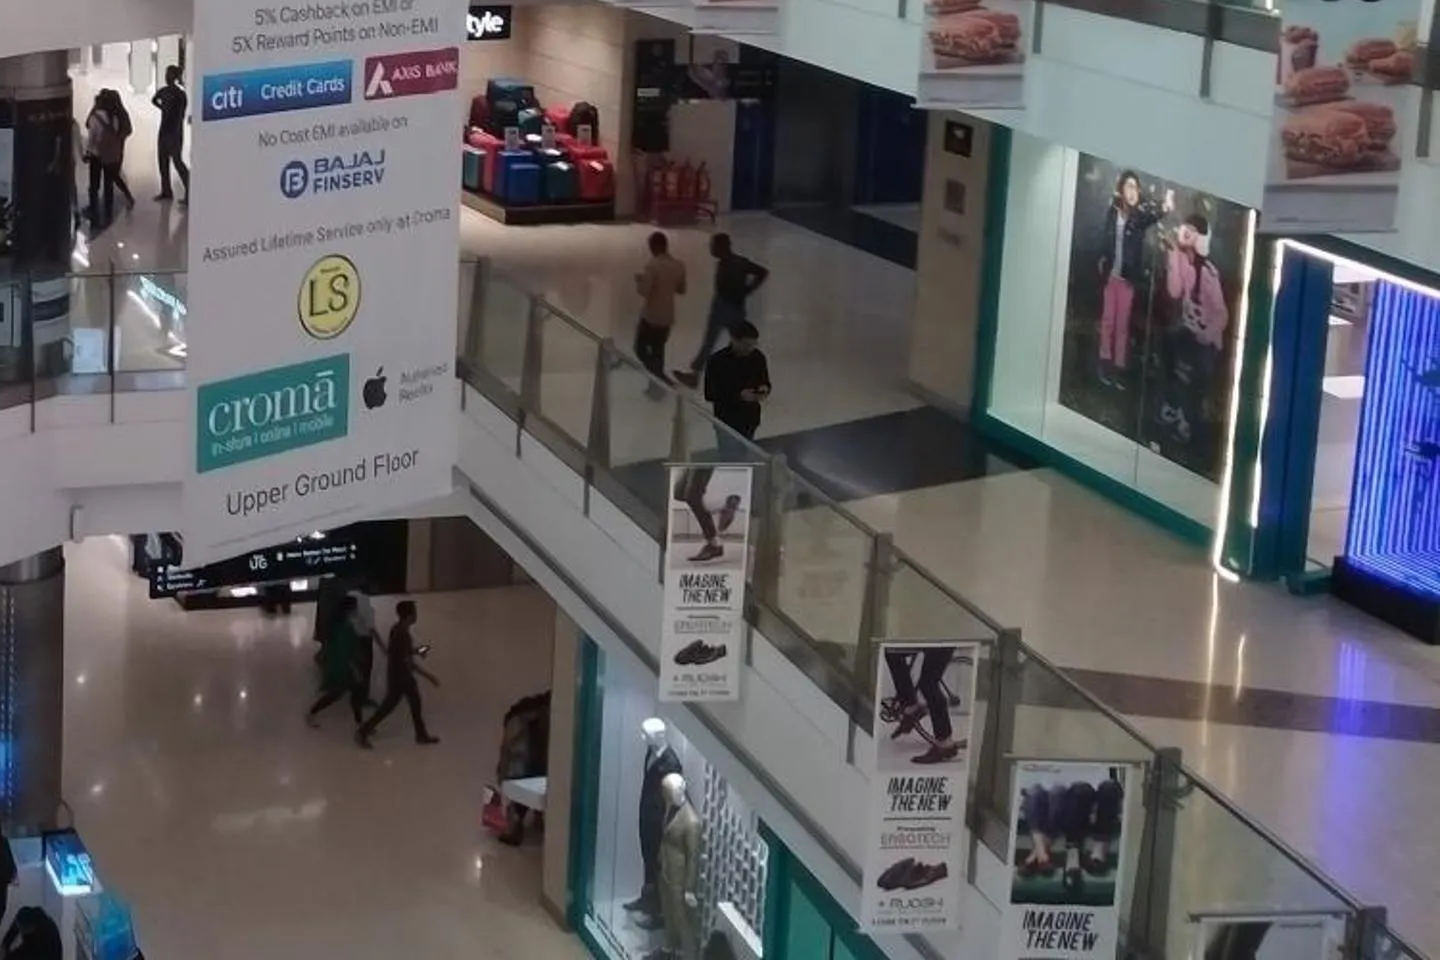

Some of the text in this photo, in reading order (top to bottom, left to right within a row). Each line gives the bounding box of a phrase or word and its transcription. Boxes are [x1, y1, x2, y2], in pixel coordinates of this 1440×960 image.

[279, 2, 348, 24] Cashback
[351, 1, 370, 16] on
[232, 36, 254, 54] 5X
[256, 30, 309, 51] Reward
[313, 26, 356, 46] Points
[379, 17, 439, 39] Non-EMI
[392, 59, 459, 81] AXIS BANK
[211, 75, 345, 111] citi Credit Cards
[259, 131, 277, 148] No
[279, 128, 311, 146] Cost
[312, 125, 336, 142] EMI
[314, 149, 386, 174] BAJAJ
[313, 167, 386, 193] FINSERV
[202, 240, 258, 263] Assured
[260, 232, 312, 252] Lifetime
[316, 222, 364, 242] Service
[367, 217, 394, 235] only
[308, 272, 350, 317] LS
[227, 448, 420, 517] Upper Ground Floor
[679, 574, 729, 589] IMAGINE
[682, 589, 732, 604] THE NEW
[887, 776, 949, 795] IMAGINE
[890, 794, 952, 812] THE NEW
[1022, 910, 1095, 932] IMAGINE
[1026, 930, 1099, 951] THE NEW
